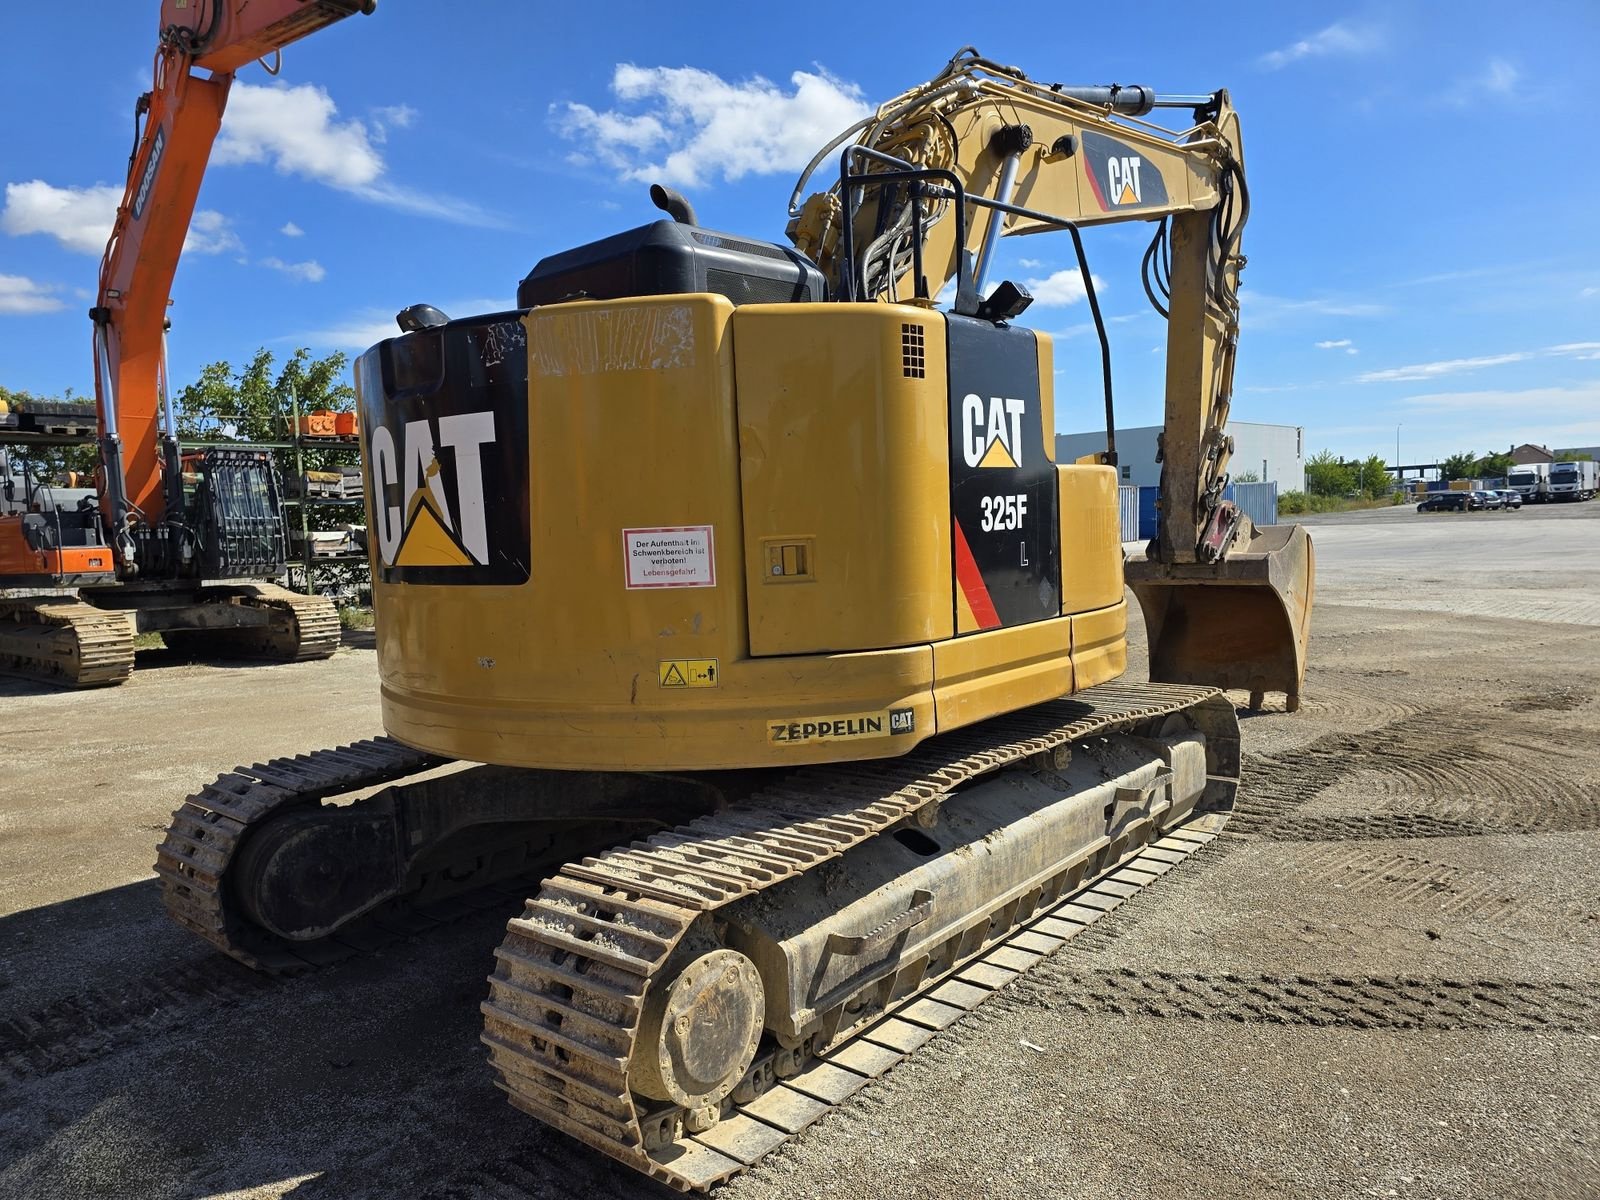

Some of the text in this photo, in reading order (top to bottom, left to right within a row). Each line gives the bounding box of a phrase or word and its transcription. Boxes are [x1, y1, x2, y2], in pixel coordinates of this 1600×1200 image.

[135, 133, 163, 216] DOOSAN
[1107, 156, 1142, 205] CAT
[962, 393, 1025, 468] CAT
[371, 411, 496, 566] CAT
[980, 494, 1027, 533] 325F
[632, 548, 693, 556] Schwenkbereich
[650, 539, 689, 547] Aufenthat
[1020, 541, 1029, 567] L
[643, 567, 696, 576] Lebensgefahr!
[651, 557, 687, 565] verboten!
[770, 711, 913, 741] ZEPPELIN CAT
